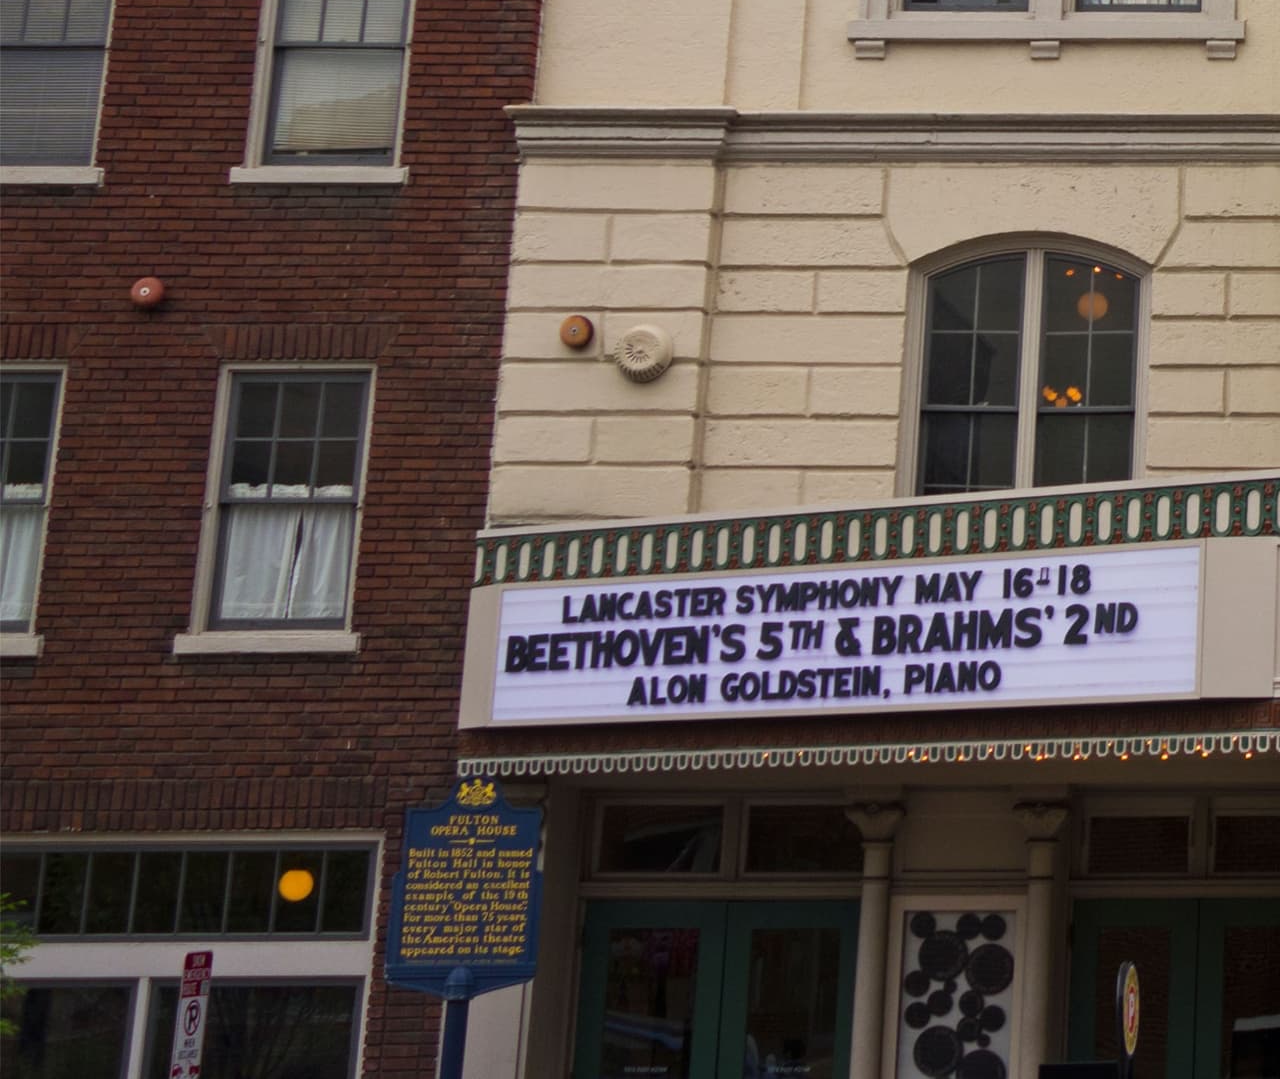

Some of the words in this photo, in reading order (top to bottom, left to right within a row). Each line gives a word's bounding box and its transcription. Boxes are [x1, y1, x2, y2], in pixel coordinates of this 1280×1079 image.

[562, 587, 727, 624] LANCASTER
[735, 575, 903, 614] SYMPHONY
[915, 570, 983, 605] MAY
[505, 624, 746, 672] BEETHOVEN'S
[756, 620, 824, 661] 5TH
[835, 618, 861, 656] &
[871, 605, 1055, 655] BRAHMS'
[1063, 603, 1139, 646] 2ND
[627, 673, 707, 706] ALON
[720, 666, 890, 701] GOLDSTEIN,
[904, 660, 1002, 695] PIANO
[450, 815, 499, 824] FULTON
[431, 826, 469, 835] OPERA
[477, 826, 517, 835] HOUSE
[409, 848, 434, 857] Built
[439, 849, 449, 857] in
[452, 848, 473, 857] 1852
[477, 848, 495, 857] and
[499, 848, 533, 857] named
[409, 859, 446, 868] Fulton
[453, 859, 477, 868] Hall
[483, 859, 493, 868] in
[498, 859, 531, 868] honor
[408, 870, 421, 879] of
[424, 870, 459, 879] Robert
[508, 870, 516, 879] It
[521, 870, 530, 879] is
[406, 881, 463, 890] considered
[483, 881, 530, 889] excellent
[405, 892, 454, 902] example
[463, 891, 475, 900] of
[481, 892, 499, 900] the
[404, 904, 448, 913] century
[404, 914, 420, 922] For
[454, 913, 478, 922] than
[482, 913, 494, 921] 75
[403, 926, 436, 935] every
[444, 925, 477, 935] major
[485, 924, 507, 932] star
[512, 923, 526, 932] of
[402, 935, 421, 944] the
[424, 935, 479, 944] American
[484, 934, 525, 943] theatre
[401, 946, 453, 956] appeared
[475, 945, 488, 954] its
